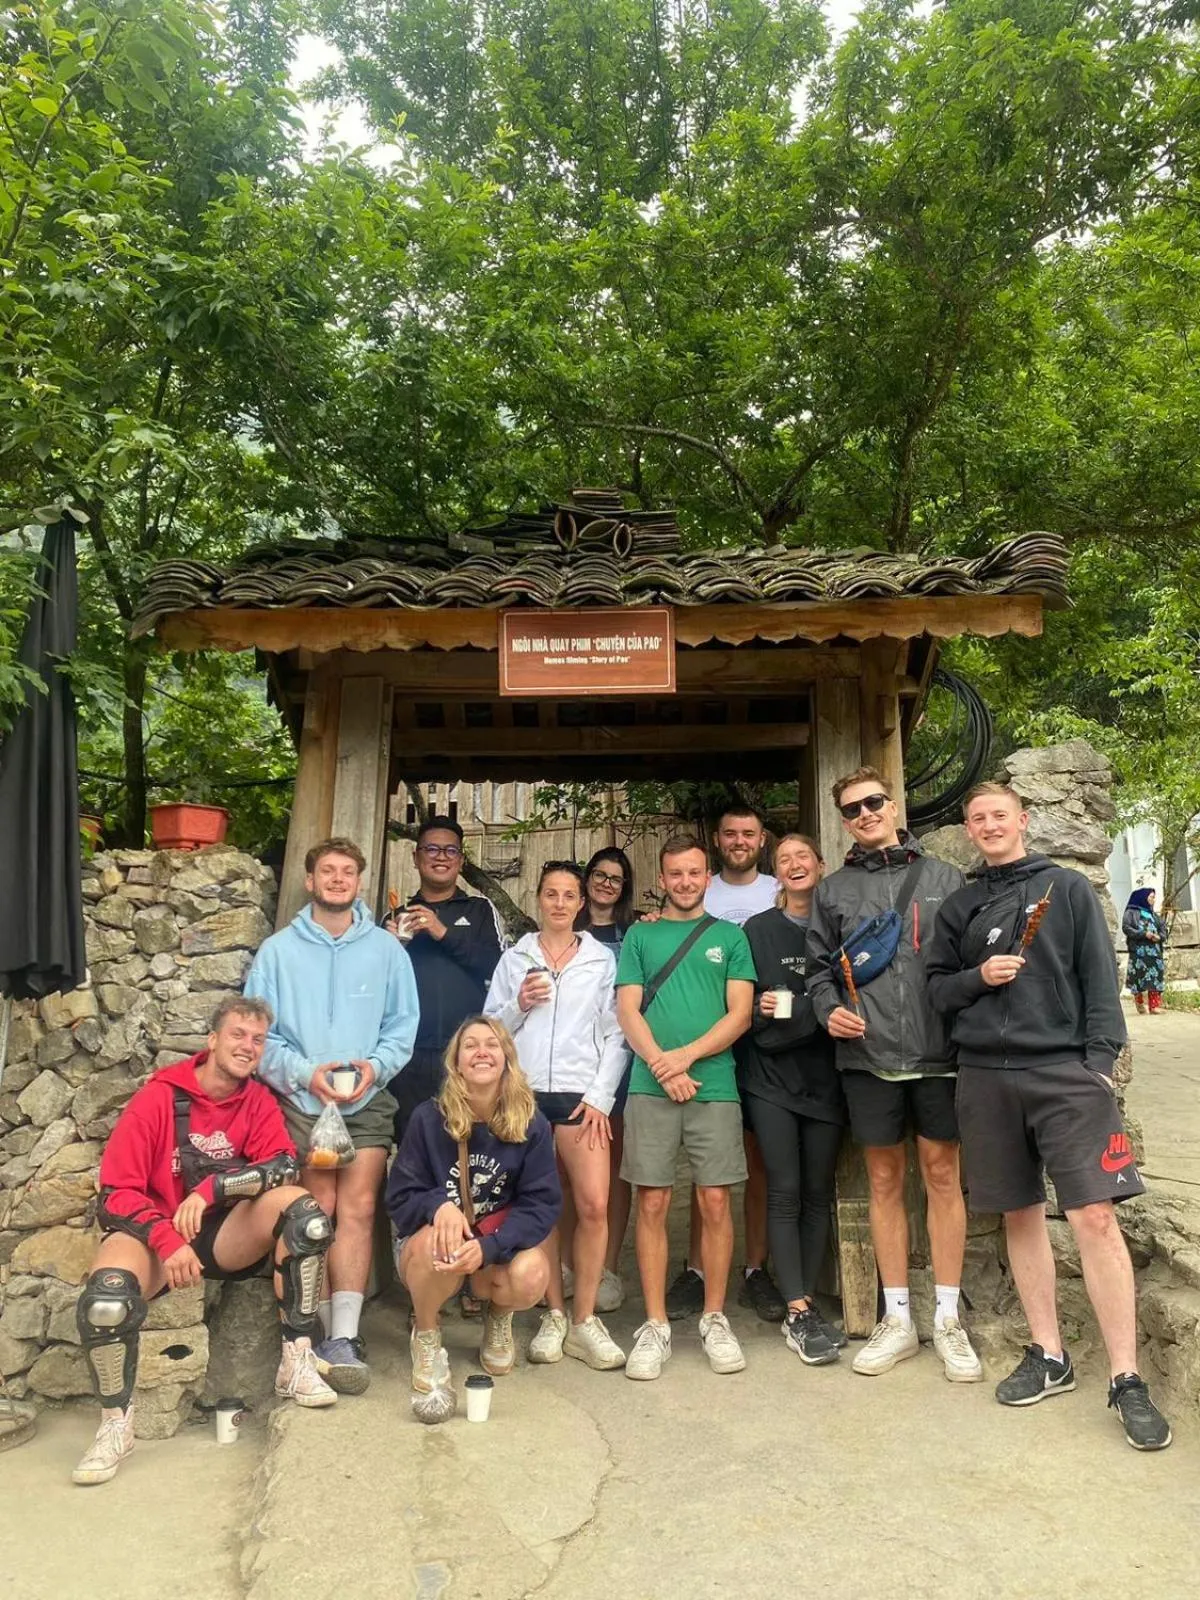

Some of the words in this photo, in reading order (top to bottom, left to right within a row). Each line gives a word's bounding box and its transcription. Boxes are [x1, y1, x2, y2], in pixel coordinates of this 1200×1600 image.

[512, 636, 531, 652] NGÔI
[532, 635, 549, 652] NHÀ
[549, 637, 570, 653] QUAY
[571, 637, 591, 651] PHIM
[627, 632, 643, 650] CỦA
[780, 956, 795, 964] NEW
[795, 956, 806, 964] YO
